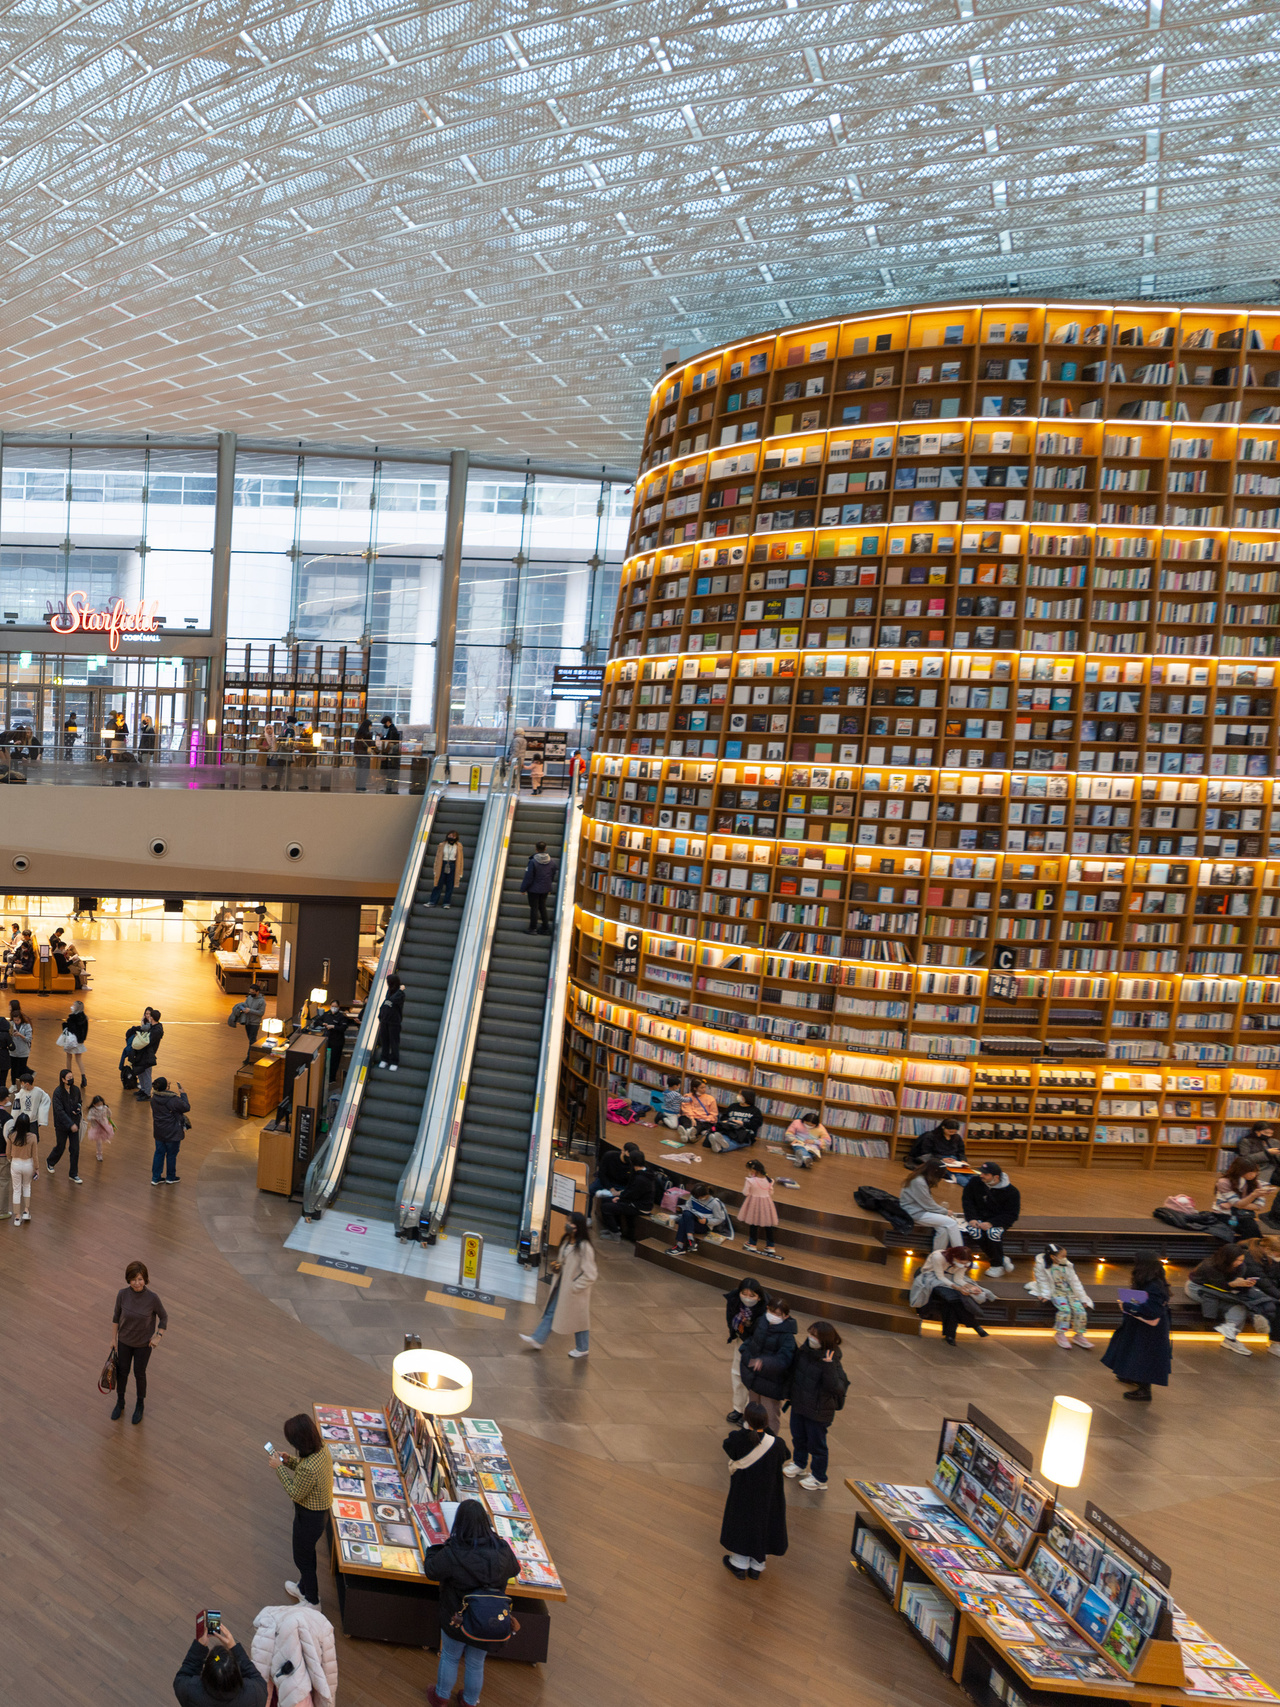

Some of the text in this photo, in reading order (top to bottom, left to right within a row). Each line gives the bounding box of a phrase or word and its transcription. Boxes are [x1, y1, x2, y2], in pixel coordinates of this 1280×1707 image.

[50, 590, 159, 652] Starfield
[142, 634, 161, 642] MALL
[627, 935, 638, 950] C
[999, 951, 1013, 969] C
